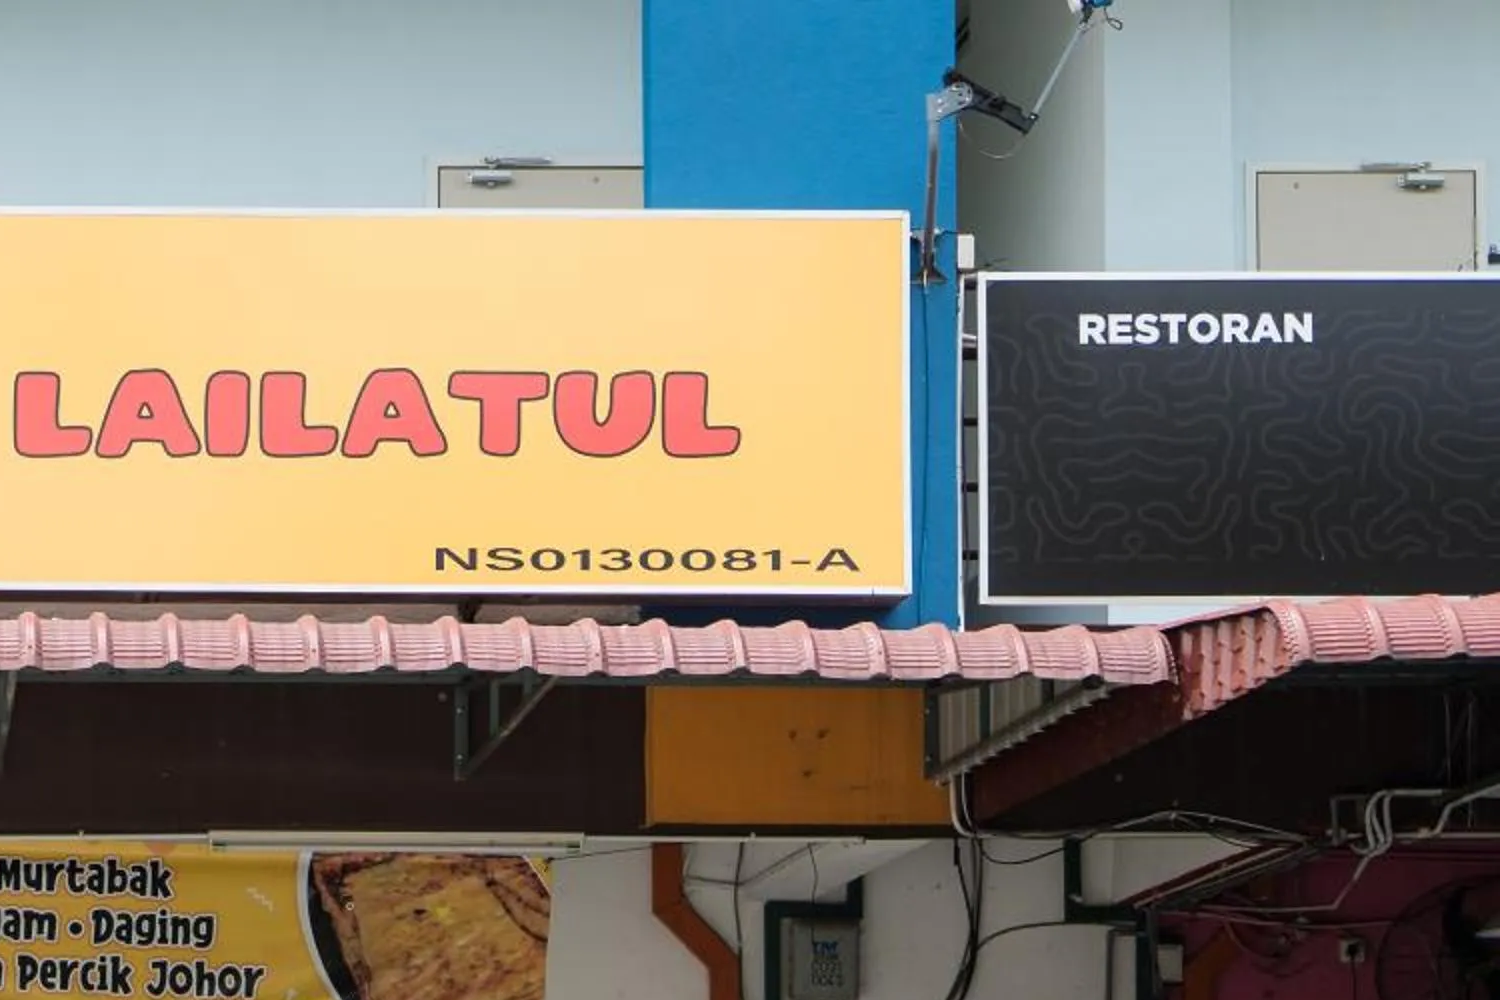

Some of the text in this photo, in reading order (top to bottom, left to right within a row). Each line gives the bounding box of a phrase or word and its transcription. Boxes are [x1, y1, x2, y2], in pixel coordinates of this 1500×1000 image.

[1078, 311, 1314, 346] RESTORAN
[12, 368, 743, 457] LAILATUL
[434, 547, 861, 573] NS0130081-A
[91, 909, 217, 949] Daging
[17, 952, 133, 995] Percik
[145, 961, 266, 1000] Johor
